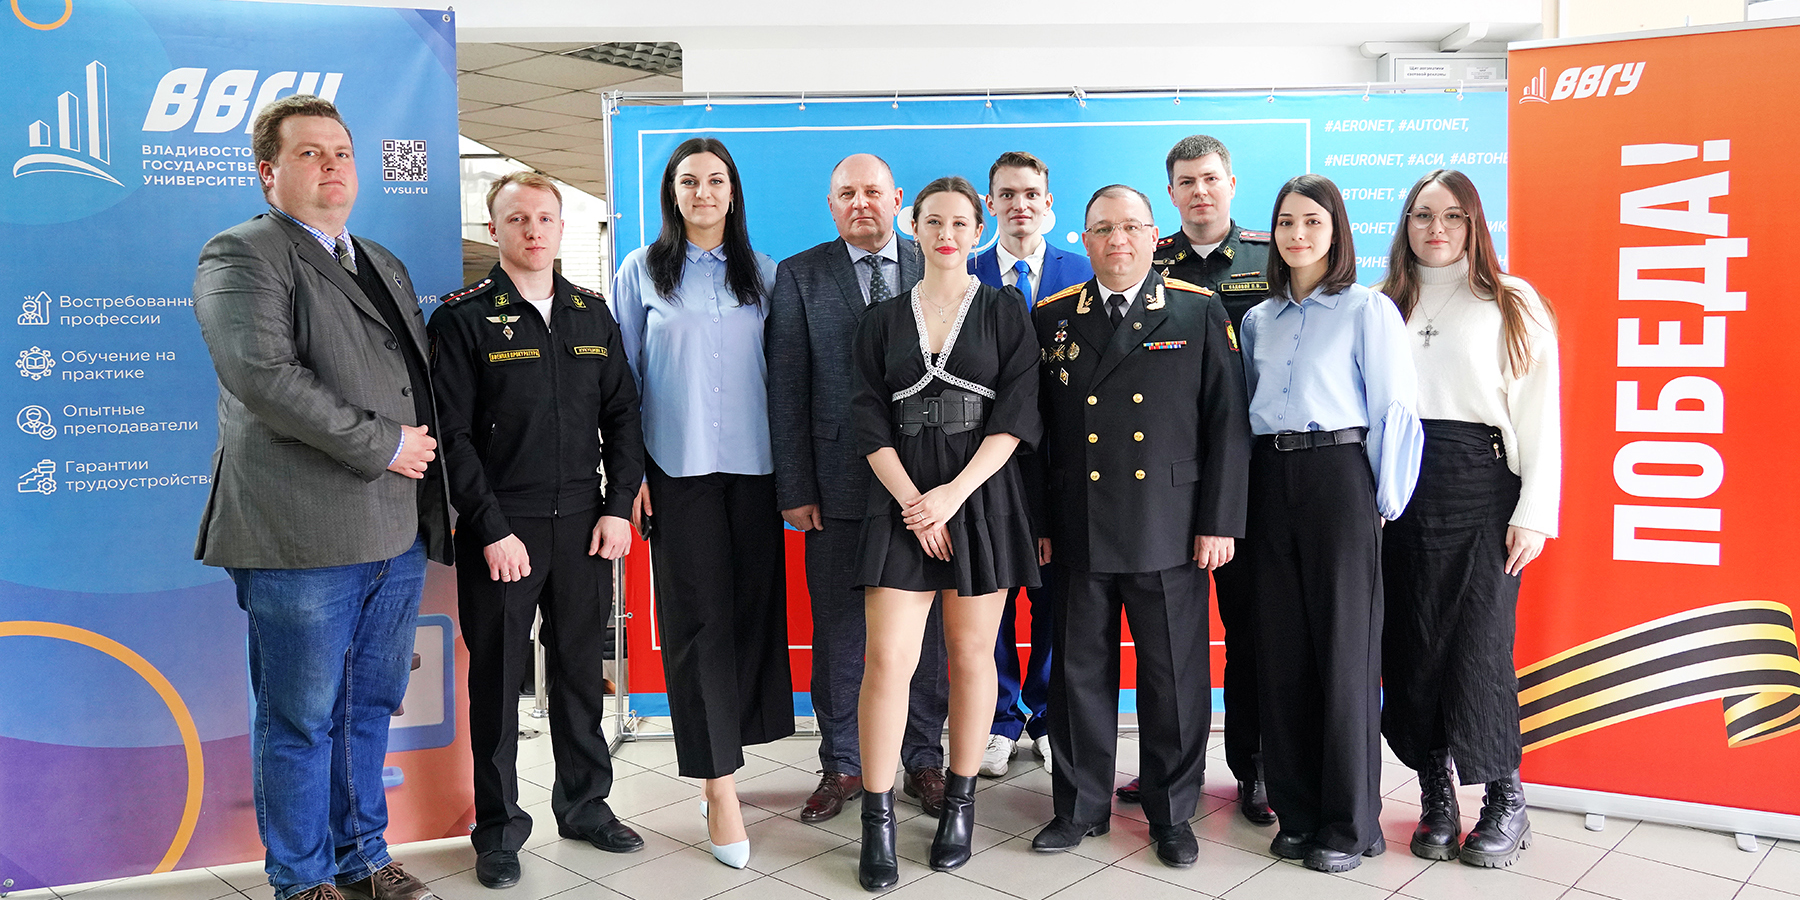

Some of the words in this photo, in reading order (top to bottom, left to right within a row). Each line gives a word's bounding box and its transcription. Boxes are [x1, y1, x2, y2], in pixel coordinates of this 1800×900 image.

[1550, 61, 1646, 101] ВВГУ
[1324, 119, 1395, 133] #AERONET,
[1398, 118, 1469, 132] #AUTONET,
[142, 145, 253, 158] ВЛАДИВОСТО
[142, 160, 257, 172] ГОСУДАРСТВЕ
[1324, 153, 1404, 167] #NEURONET,
[1407, 153, 1446, 167] #АСИ,
[143, 175, 256, 187] УНИВЕРСИТЕТ
[383, 186, 429, 195] vvsu.ru
[1342, 188, 1395, 202] ВТОНЕТ,
[1351, 222, 1396, 236] РОНЕТ,
[1355, 256, 1391, 268] РИНЕ
[60, 313, 161, 327] профессии
[61, 350, 150, 365] Обучение
[156, 351, 176, 361] на
[1612, 139, 1748, 566] ПОБЕДА!
[62, 369, 145, 382] практике
[63, 405, 145, 417] Опытные
[64, 421, 199, 436] преподаватели
[65, 460, 149, 474] Гарантии
